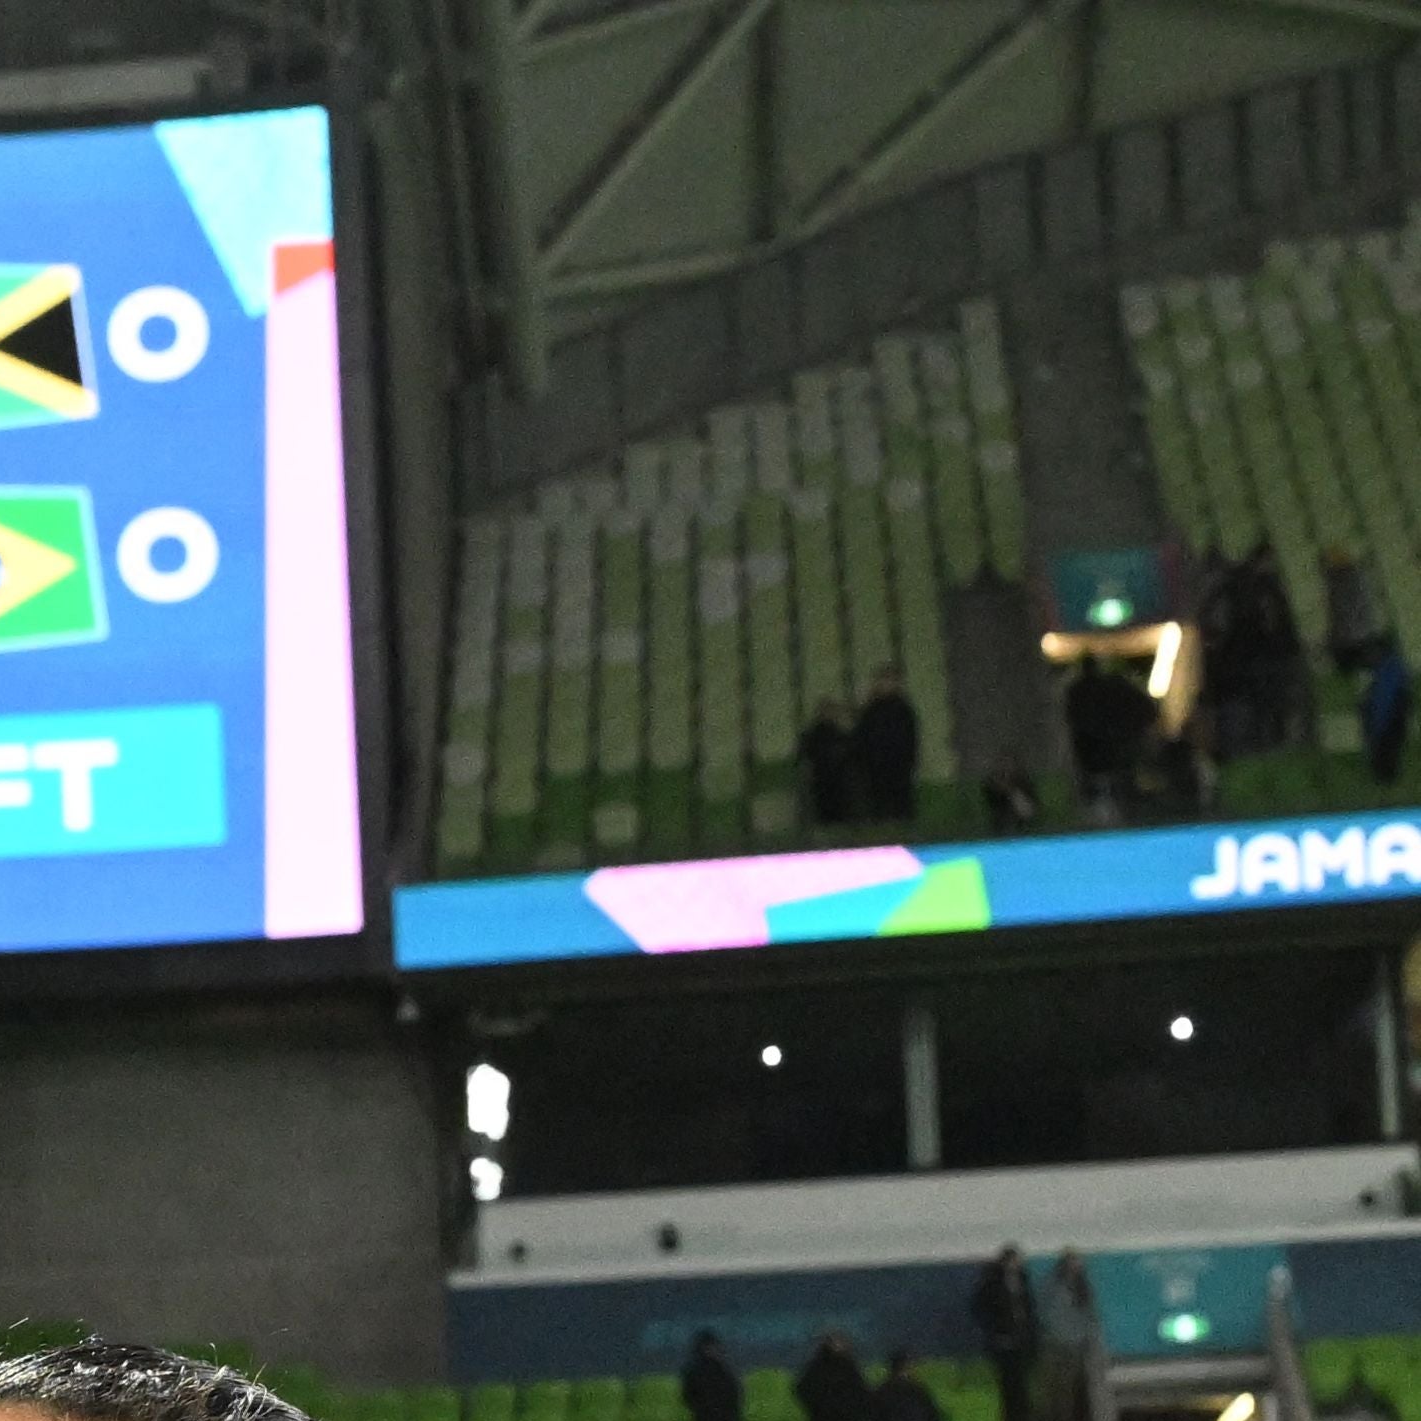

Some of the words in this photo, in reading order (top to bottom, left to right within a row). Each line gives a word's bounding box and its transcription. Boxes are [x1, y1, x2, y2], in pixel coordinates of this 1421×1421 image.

[108, 286, 209, 382] 0
[117, 507, 219, 603] 0
[1191, 825, 1421, 899] JAMA
